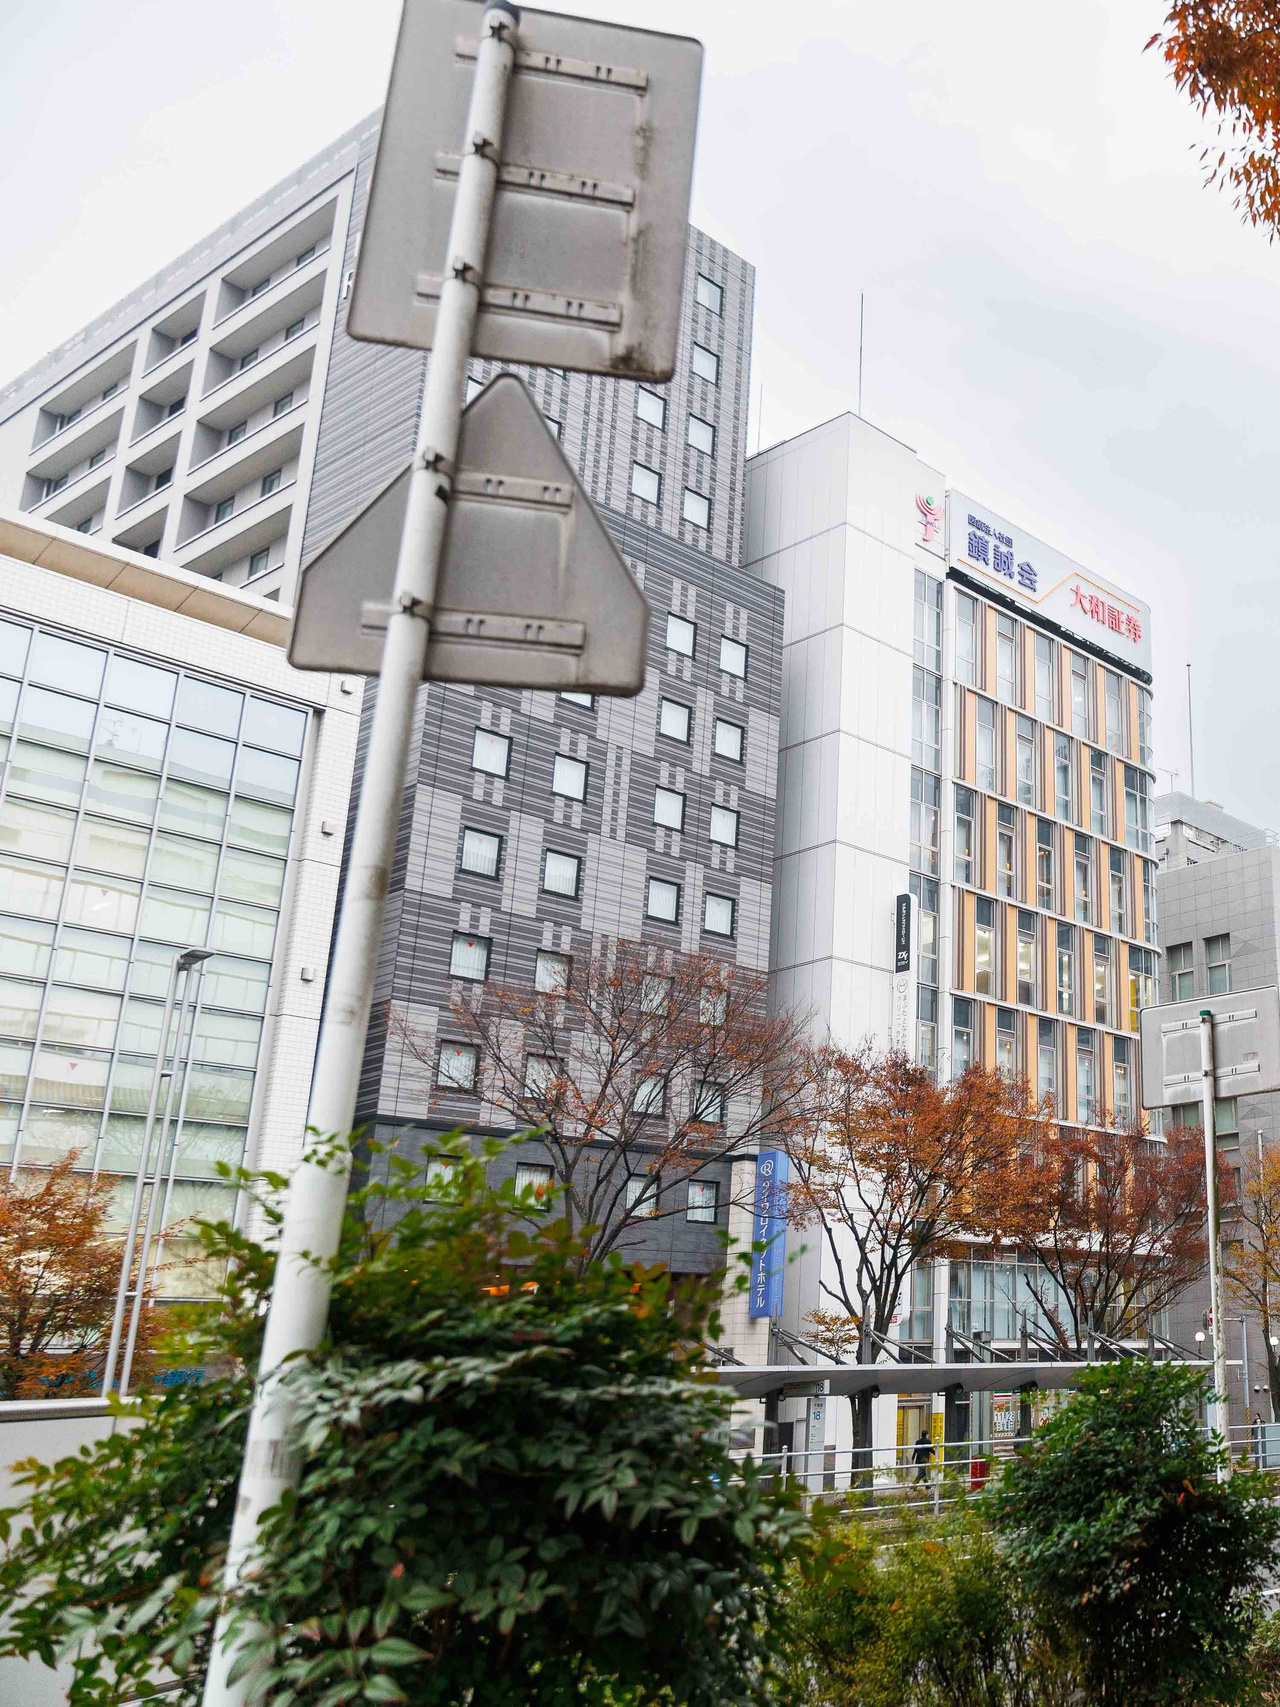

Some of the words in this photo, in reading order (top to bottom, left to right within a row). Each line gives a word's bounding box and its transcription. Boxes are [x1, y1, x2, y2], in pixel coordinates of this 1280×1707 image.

[1070, 584, 1144, 643] 大和証券
[816, 1382, 824, 1393] 18
[812, 1411, 821, 1421] 18
